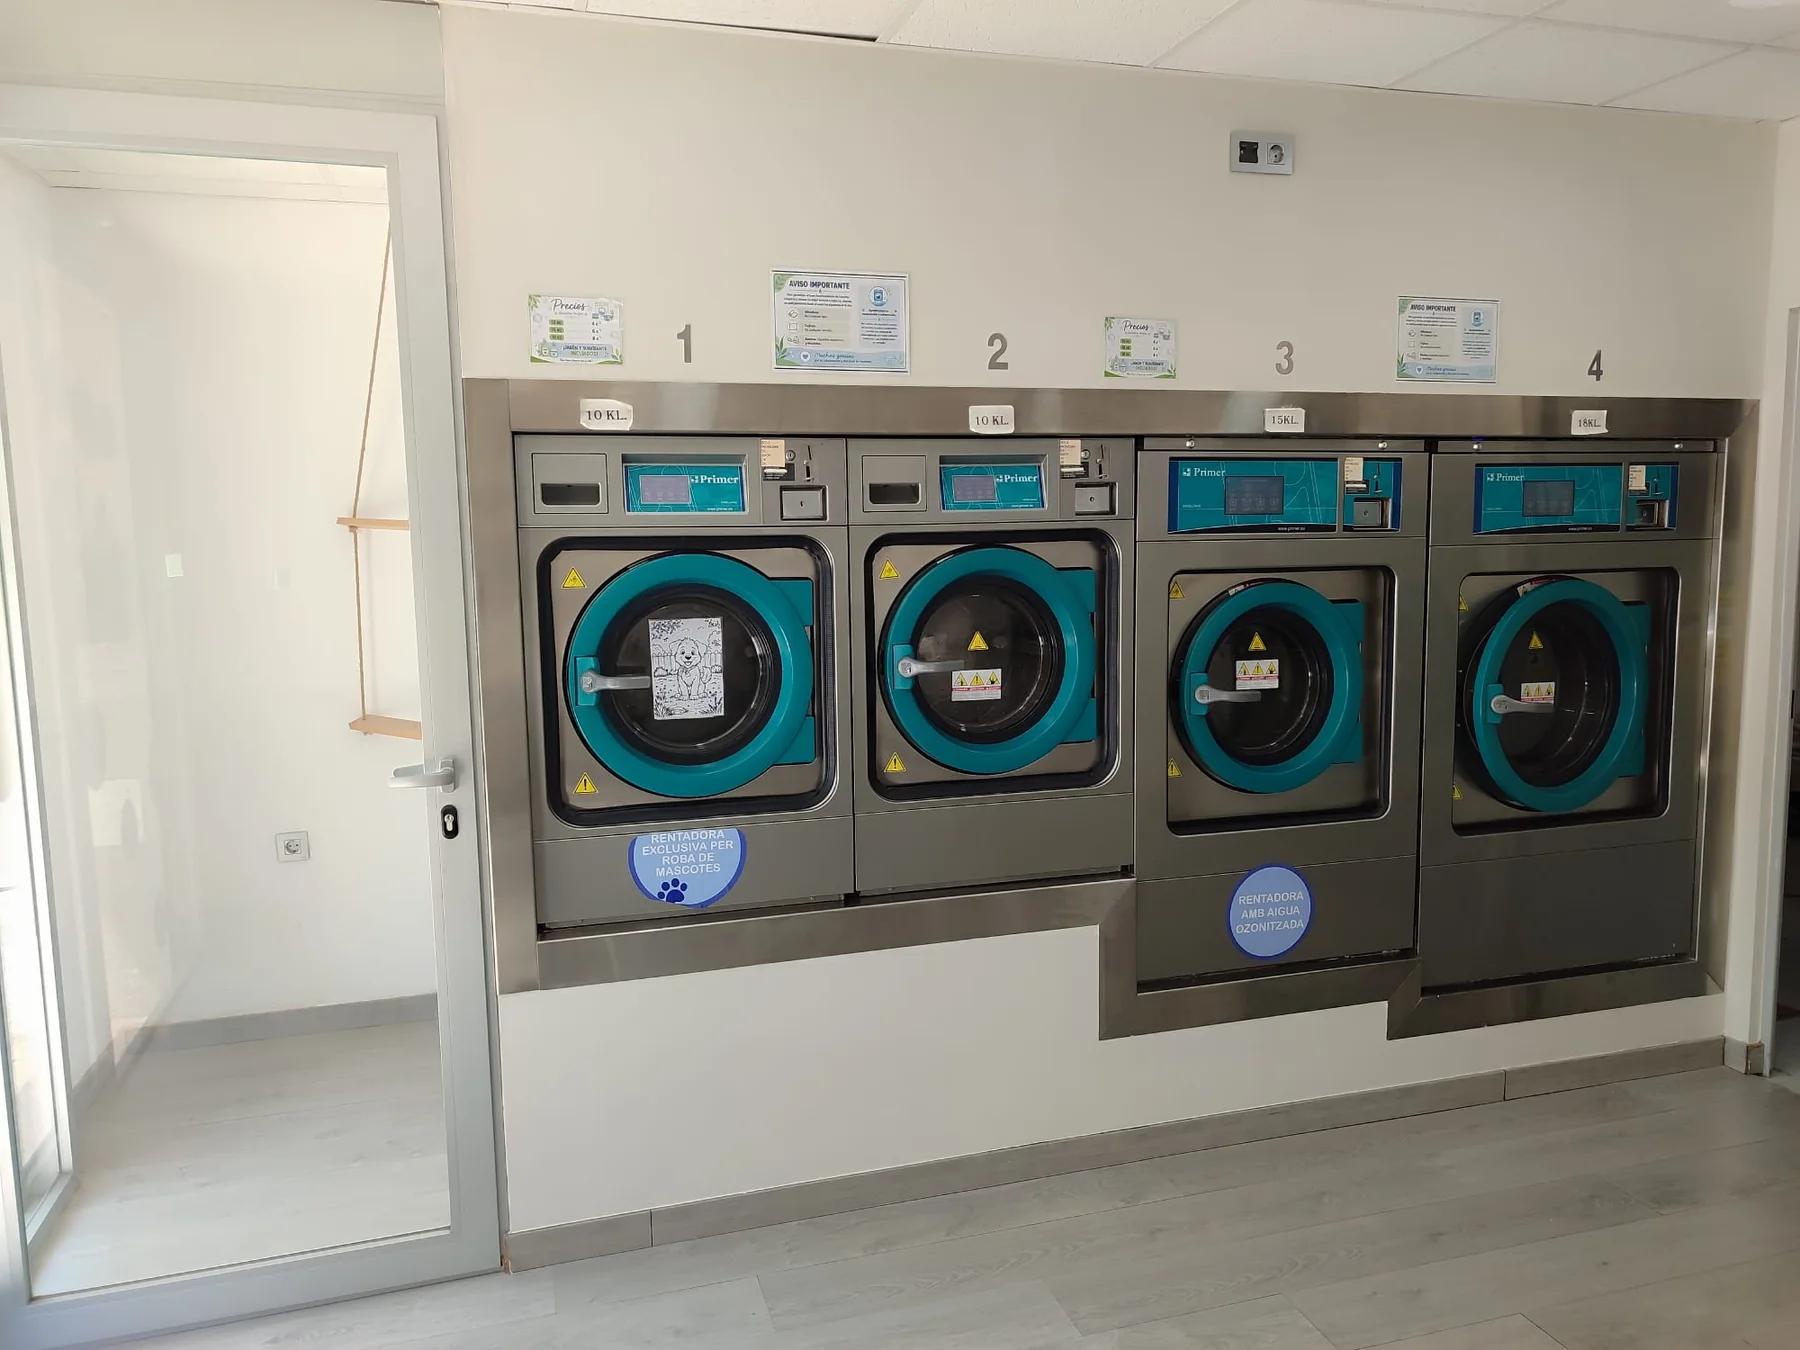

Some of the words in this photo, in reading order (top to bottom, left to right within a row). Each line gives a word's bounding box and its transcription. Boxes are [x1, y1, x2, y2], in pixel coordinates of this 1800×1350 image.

[789, 280, 808, 288] AVISO
[810, 281, 850, 290] IMPORTANTE
[551, 298, 587, 311] Precios
[1123, 319, 1149, 331] Precios
[677, 324, 691, 363] 1
[988, 332, 1008, 370] 2
[1275, 340, 1294, 375] 3
[1588, 349, 1603, 381] 4
[586, 409, 603, 421] 10
[976, 415, 989, 426] 10
[992, 415, 1009, 426] KL.
[1272, 415, 1300, 425] 15KL.
[1004, 473, 1038, 483] Primer
[1193, 467, 1226, 477] Primer
[1496, 472, 1525, 482] Primer
[700, 474, 739, 484] Primer
[651, 829, 725, 844] RENTADORA
[642, 842, 708, 856] EXCLUSIVA
[710, 840, 734, 850] PER
[662, 853, 696, 865] ROBA
[698, 852, 715, 862] DE
[655, 863, 721, 877] MASCOTES
[1238, 891, 1304, 905] RENTADORA
[1241, 908, 1265, 919] AMB
[1267, 905, 1300, 917] AIGUA
[1236, 919, 1304, 934] OZONITZADA
